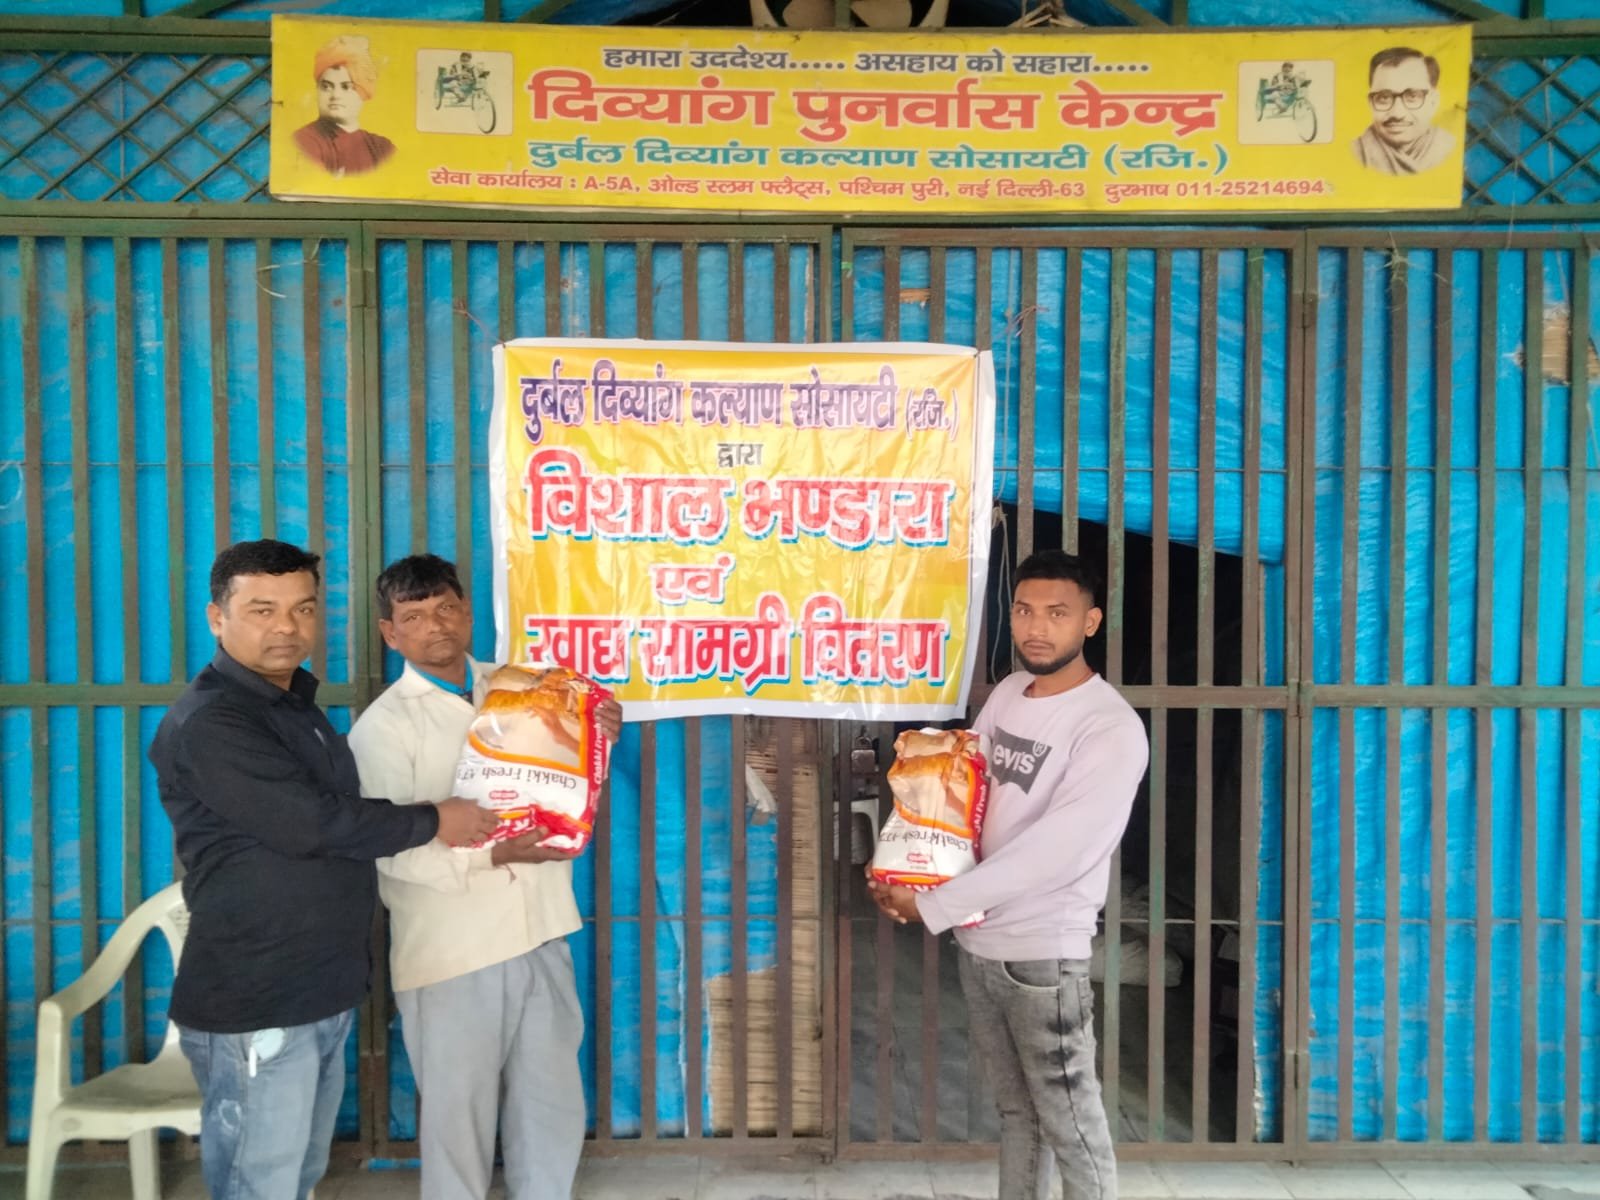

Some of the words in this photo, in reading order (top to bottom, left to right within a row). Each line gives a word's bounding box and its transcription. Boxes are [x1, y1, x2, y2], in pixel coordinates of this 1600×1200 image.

[603, 48, 681, 68] हमारा
[854, 52, 958, 73] असहाय
[966, 49, 1005, 72] को
[527, 69, 775, 126] दिव्यांग
[792, 78, 1041, 142] पुनर्वास
[1058, 80, 1223, 136] केन्द्र
[528, 137, 626, 168] दुर्बल
[633, 138, 769, 166] दिव्यांग
[779, 147, 918, 168] कल्याण
[928, 143, 1090, 169] सोसायटी
[1103, 142, 1228, 175] (रजि.)
[430, 167, 471, 186] सेवा
[477, 170, 563, 189] कार्यालय
[583, 175, 640, 192] A-5A,
[648, 174, 700, 194] ओल्ड
[706, 179, 754, 194] स्लम
[839, 176, 905, 196] पश्चिम
[957, 178, 992, 198] नई
[997, 178, 1085, 198] दिल्ली-63
[1104, 183, 1170, 203] दुरभाष
[1176, 180, 1325, 197] 011-25214694
[519, 359, 587, 443] दुर्बल
[591, 359, 684, 423] दिव्यांग
[690, 381, 784, 426] कल्याण
[790, 365, 899, 428] सोसायटी
[717, 442, 763, 467] द्वारा
[526, 449, 732, 541] विशाल
[743, 478, 953, 549] भण्डारा
[652, 555, 734, 603] एवं
[526, 615, 630, 681] खाद्य
[640, 595, 793, 693] सामग्री
[803, 594, 950, 687] वितरण
[481, 766, 521, 781] Fresh
[527, 768, 577, 790] Chakki
